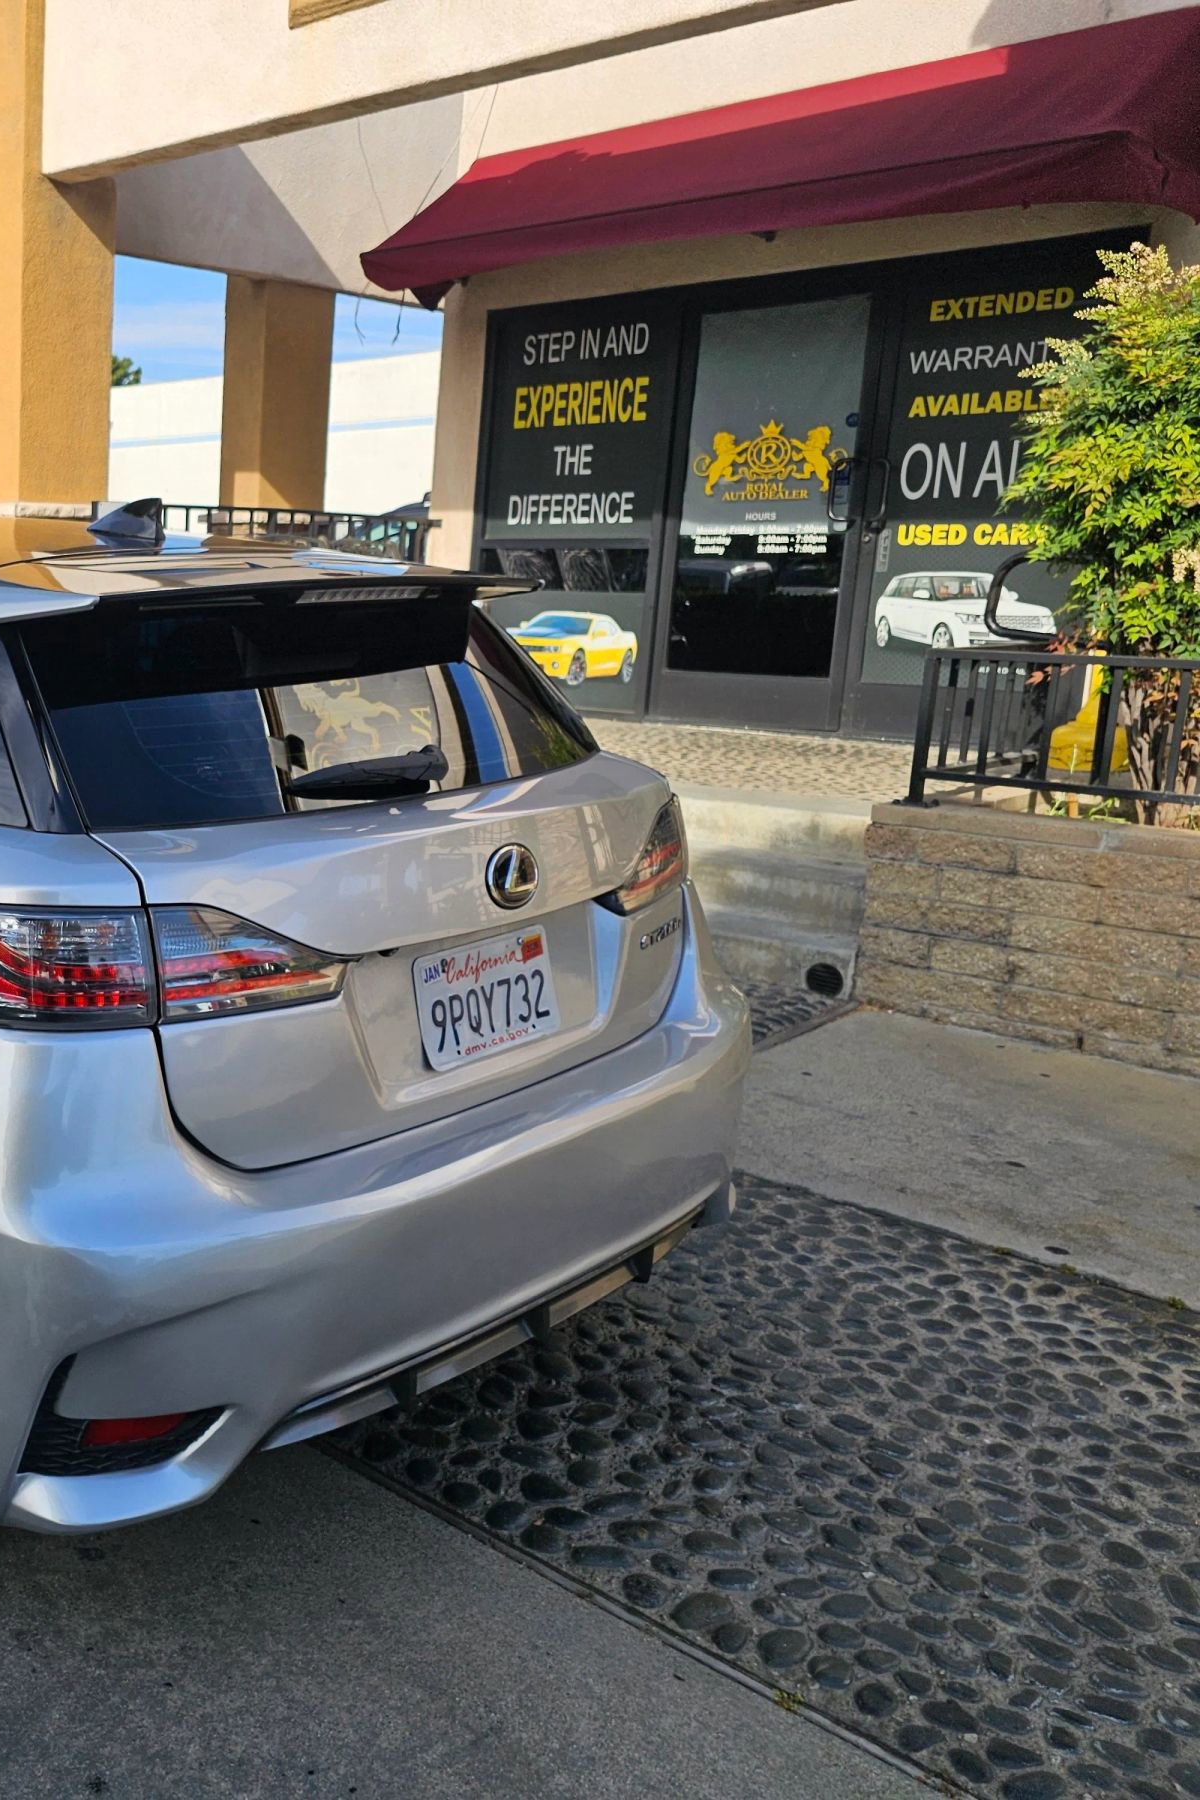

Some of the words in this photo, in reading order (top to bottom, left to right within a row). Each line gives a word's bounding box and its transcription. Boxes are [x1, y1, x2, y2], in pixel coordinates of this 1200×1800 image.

[929, 287, 1075, 322] EXTENDED
[523, 331, 576, 366] STEP
[580, 328, 601, 360] IN
[603, 323, 650, 358] AND
[909, 339, 1062, 375] WARRANT
[513, 376, 650, 429] EXPERIENCE
[553, 444, 594, 476] THE
[760, 443, 780, 465] R
[746, 482, 784, 493] ROYAL
[900, 442, 967, 501] ON
[507, 491, 635, 525] DIFFERENCE
[722, 491, 759, 501] AUTO
[760, 489, 809, 500] DEALER
[745, 512, 776, 521] HOURS
[897, 523, 968, 546] USED
[423, 963, 441, 984] JAN
[445, 950, 528, 984] California
[431, 969, 550, 1053] 9PQY732
[464, 1026, 529, 1056] dmv.ca.gov
